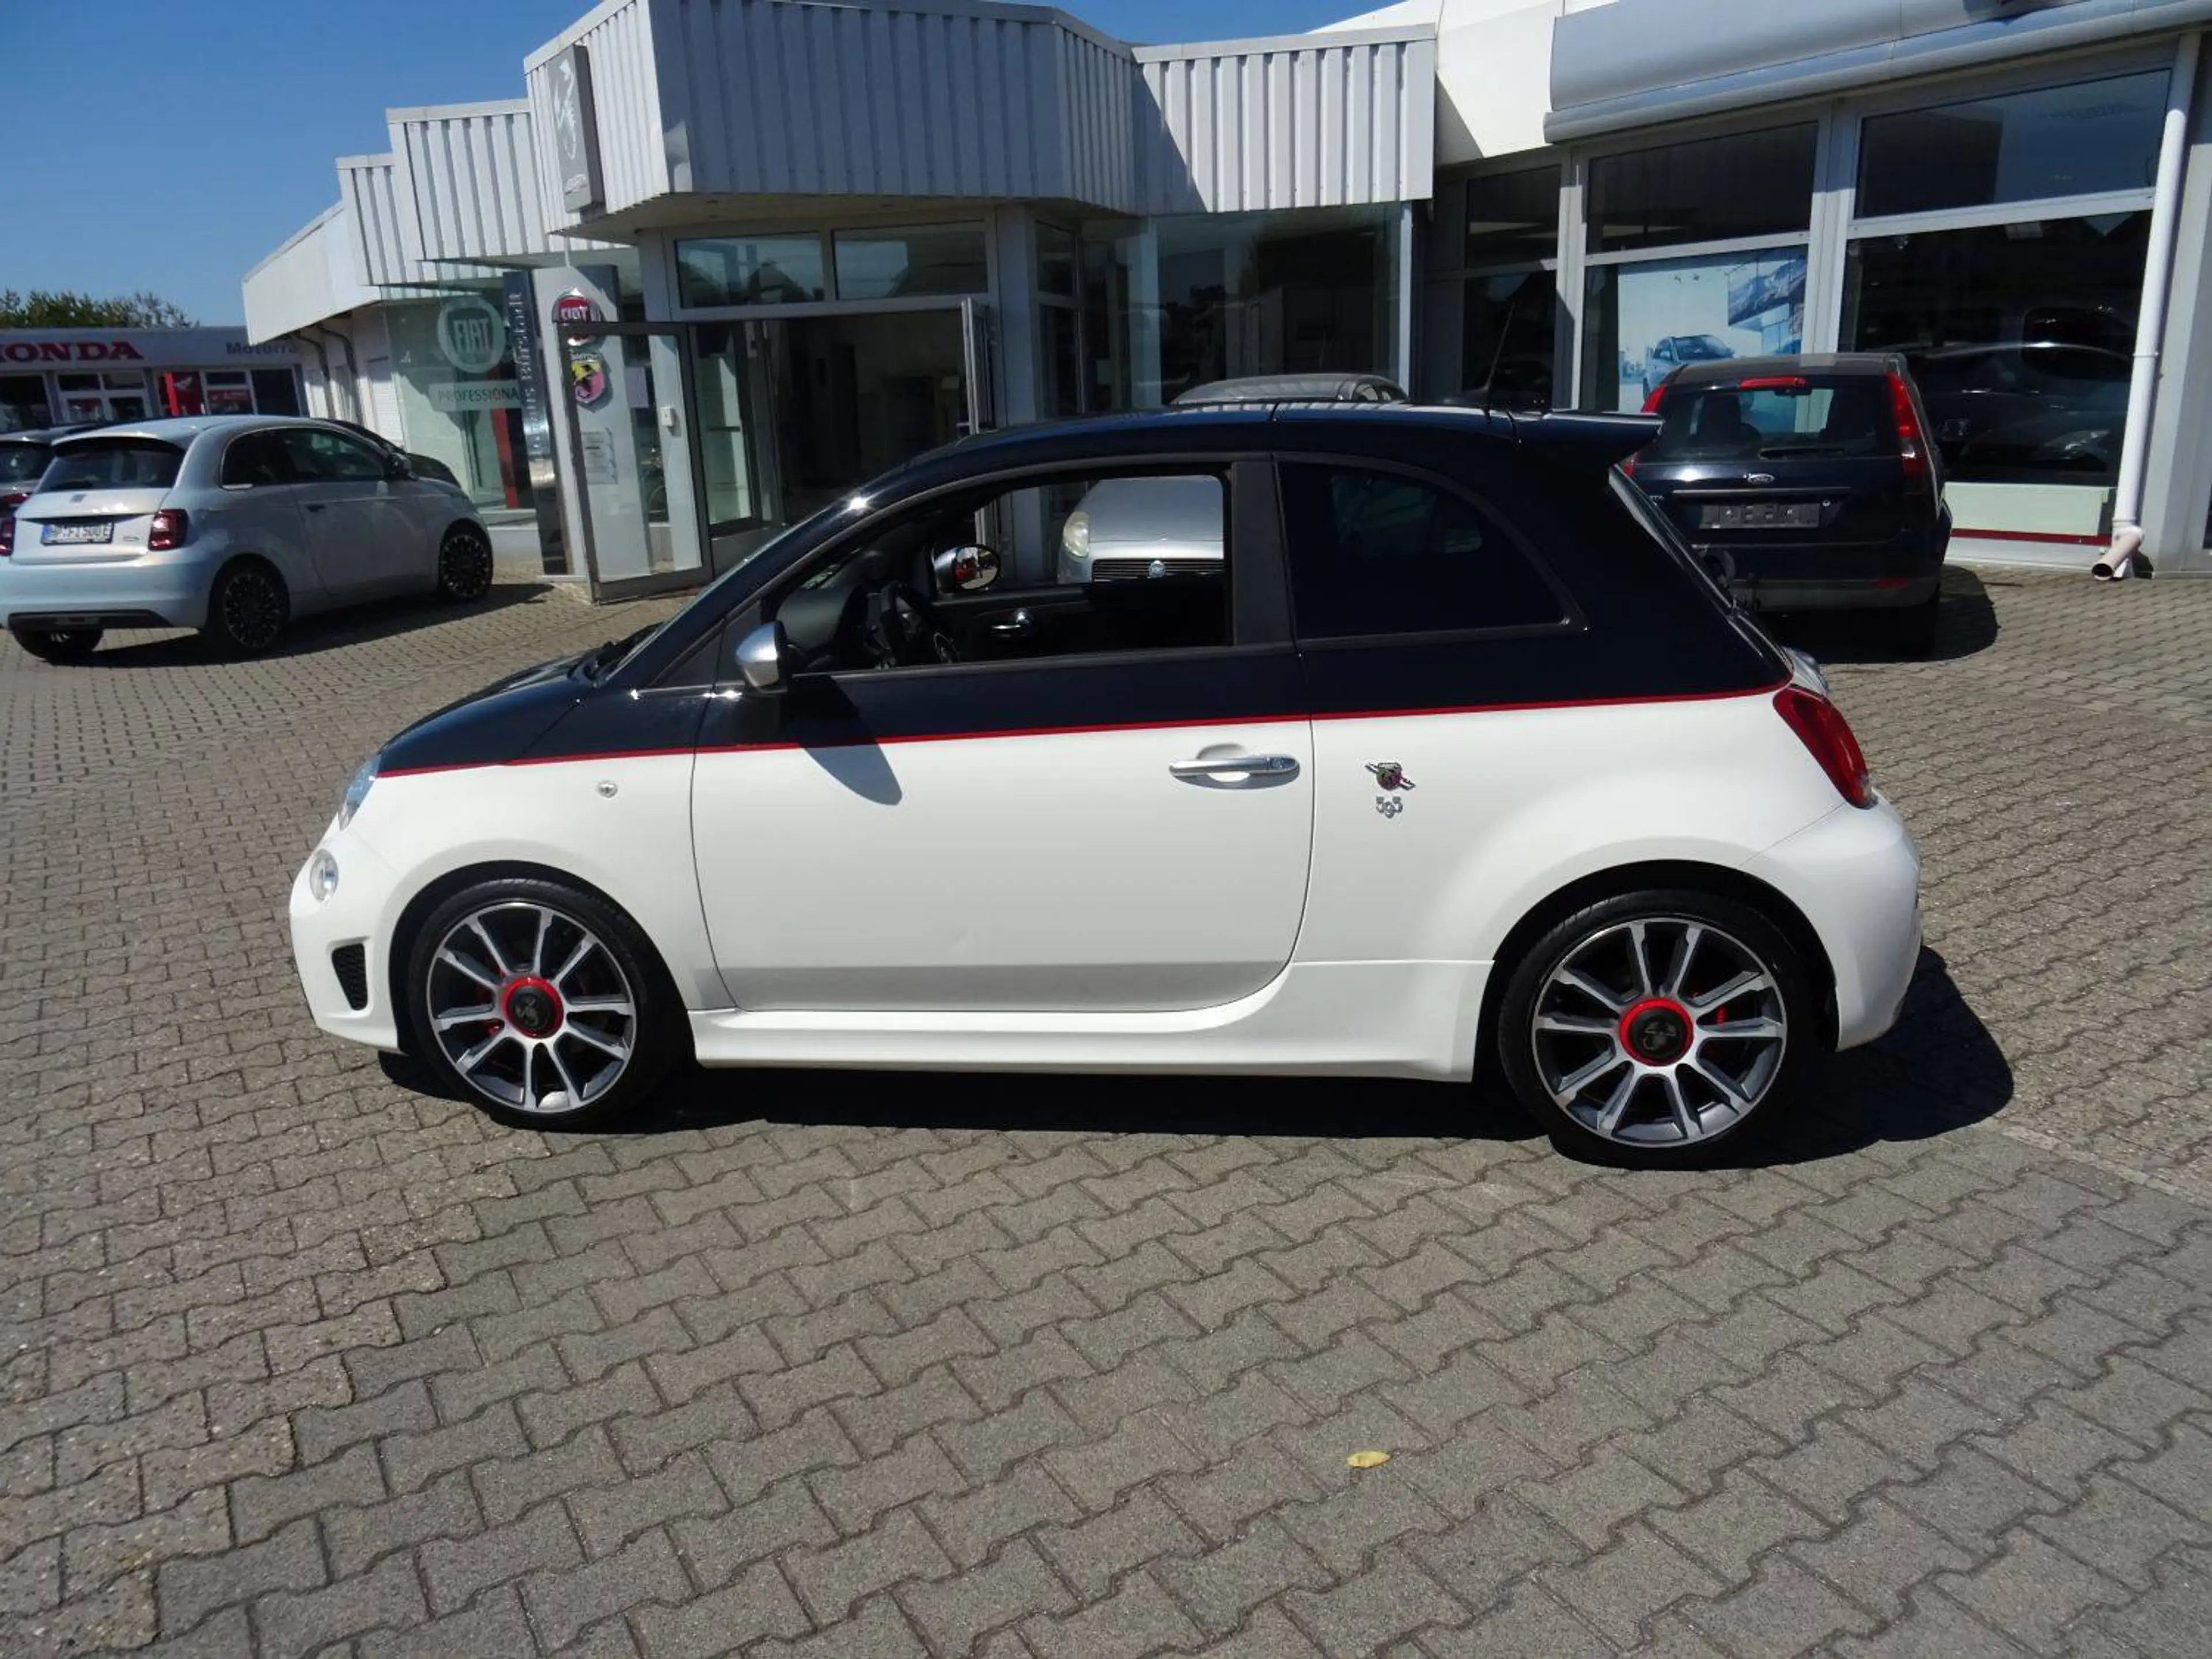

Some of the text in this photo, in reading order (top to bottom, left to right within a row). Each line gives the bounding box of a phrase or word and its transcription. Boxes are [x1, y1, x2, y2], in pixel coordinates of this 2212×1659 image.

[453, 319, 490, 355] FIAT
[0, 341, 144, 362] ONDA
[225, 341, 299, 355] Motorra
[437, 387, 520, 403] PROFESSIONA
